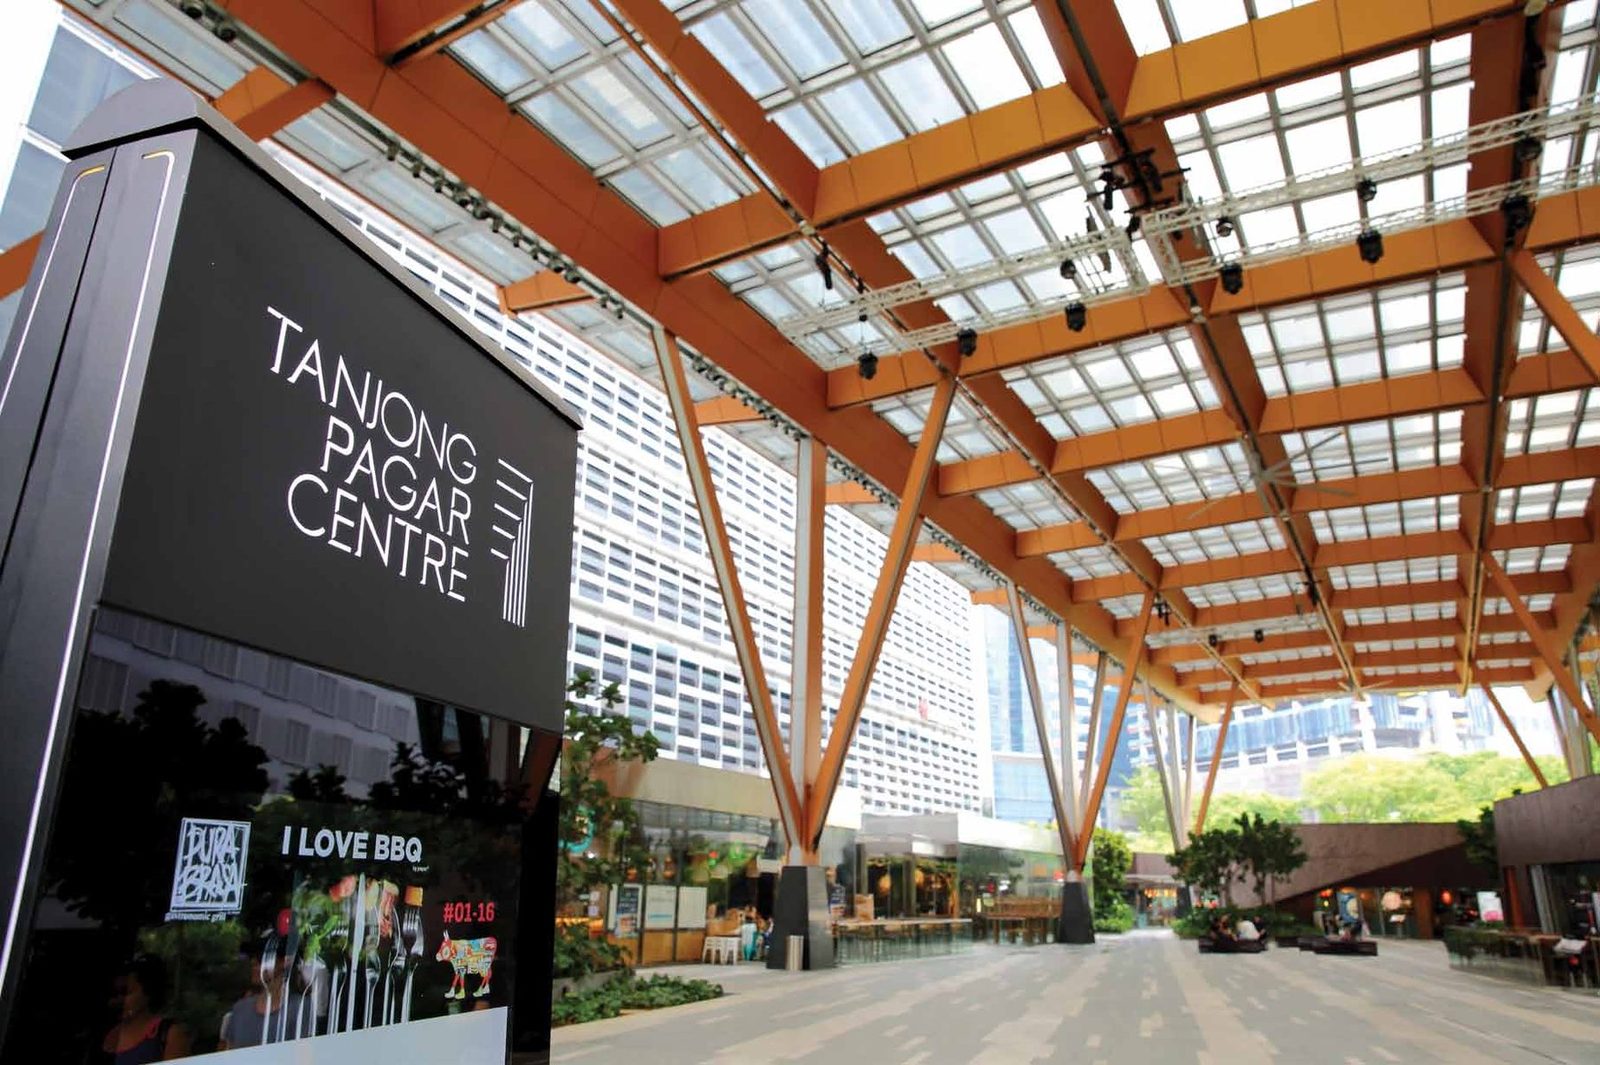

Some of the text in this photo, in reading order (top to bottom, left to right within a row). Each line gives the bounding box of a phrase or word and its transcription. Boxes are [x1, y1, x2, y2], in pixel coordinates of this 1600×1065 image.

[267, 306, 477, 484] TANJONG
[287, 473, 470, 603] CENTRE
[319, 414, 472, 545] PAGAR
[281, 825, 423, 863] I LOVE BBQ
[443, 902, 495, 923] #01-16
